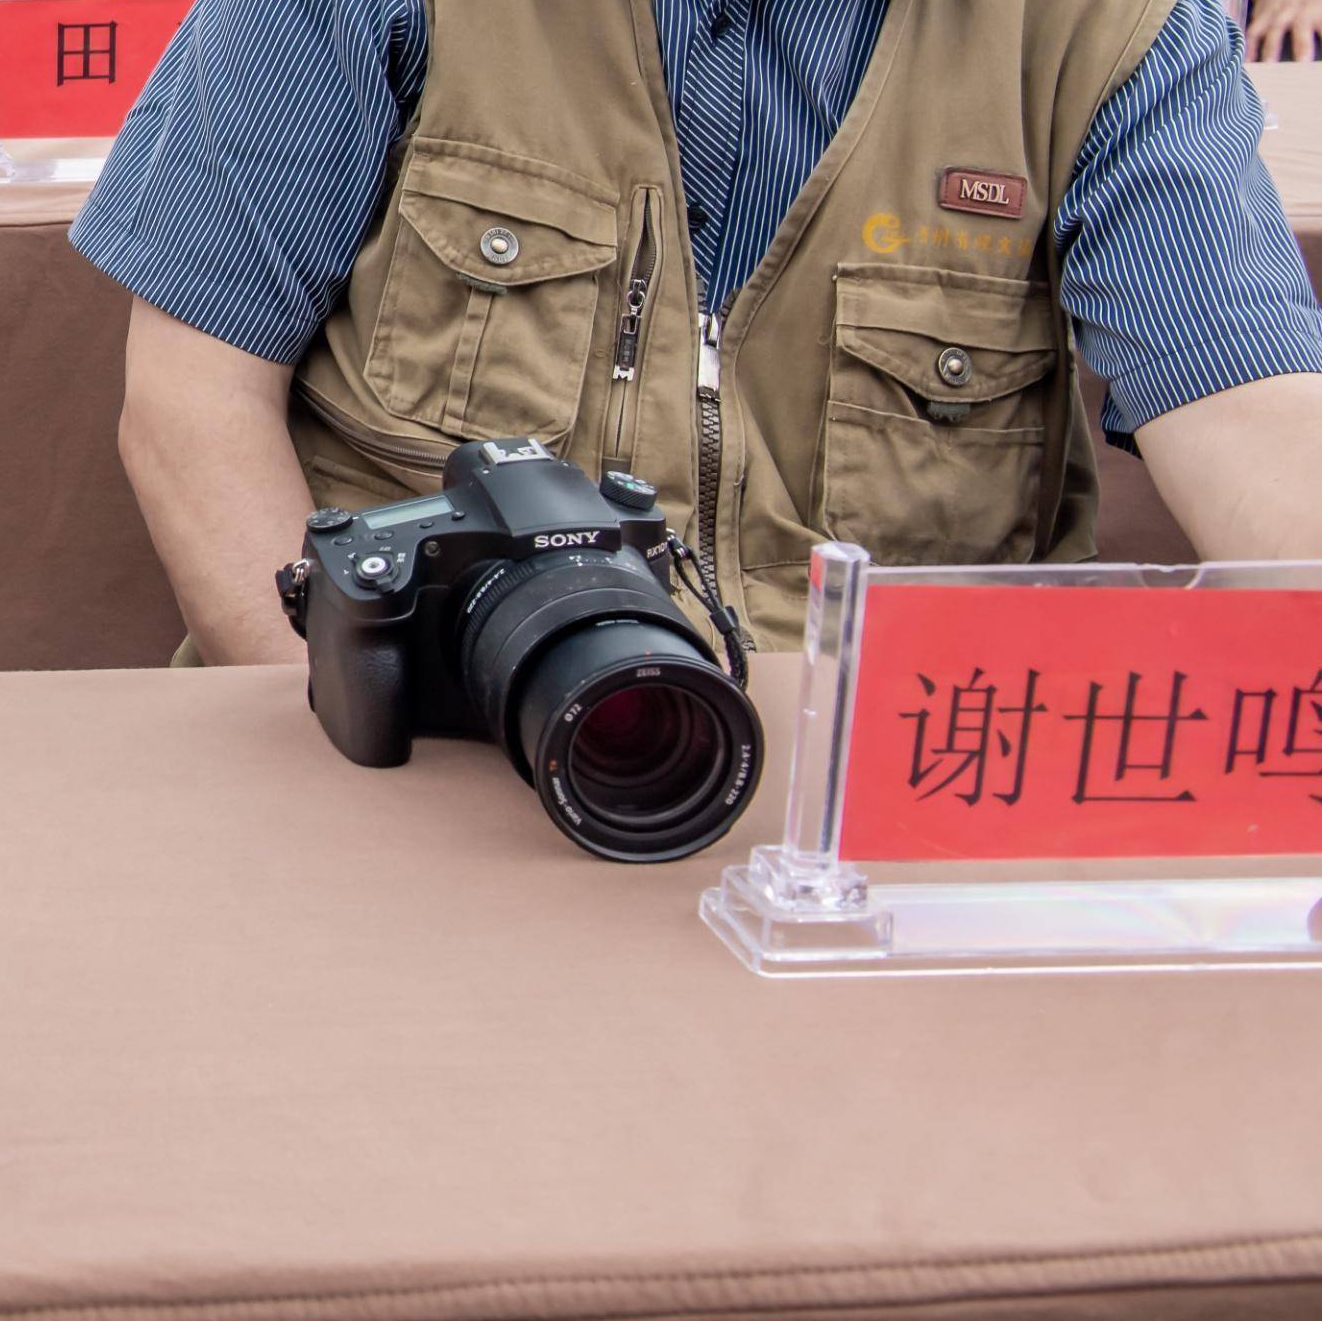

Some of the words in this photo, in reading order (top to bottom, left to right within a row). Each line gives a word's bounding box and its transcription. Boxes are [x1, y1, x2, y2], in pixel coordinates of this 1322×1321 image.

[56, 20, 118, 87] 田
[960, 179, 1010, 205] MSDL
[533, 530, 600, 548] SONY
[636, 668, 661, 678] ZEISS
